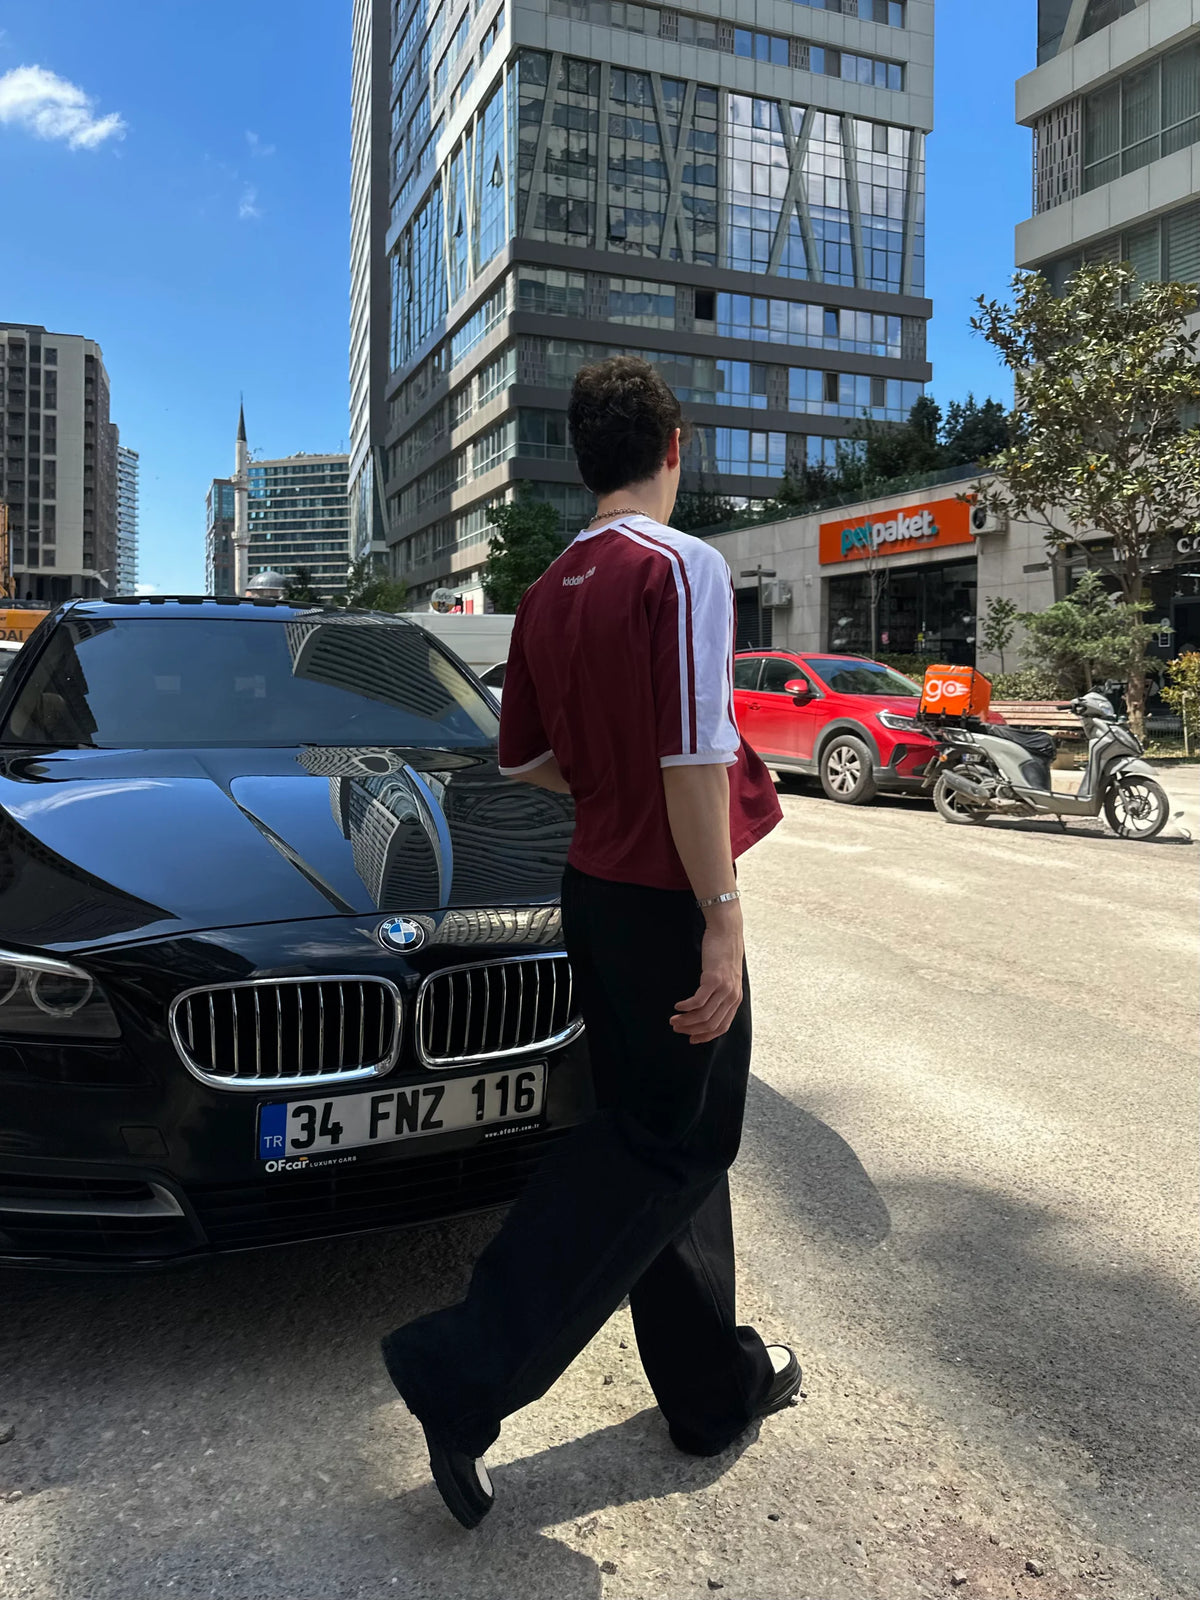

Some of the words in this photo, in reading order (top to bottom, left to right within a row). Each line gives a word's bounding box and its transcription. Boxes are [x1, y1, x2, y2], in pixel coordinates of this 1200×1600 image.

[382, 917, 418, 930] BMW
[290, 1101, 343, 1149] 34
[369, 1085, 446, 1139] FNZ
[471, 1071, 537, 1121] 116
[263, 1135, 283, 1149] TR
[309, 1159, 337, 1168] LUXURY
[338, 1155, 358, 1164] CARS
